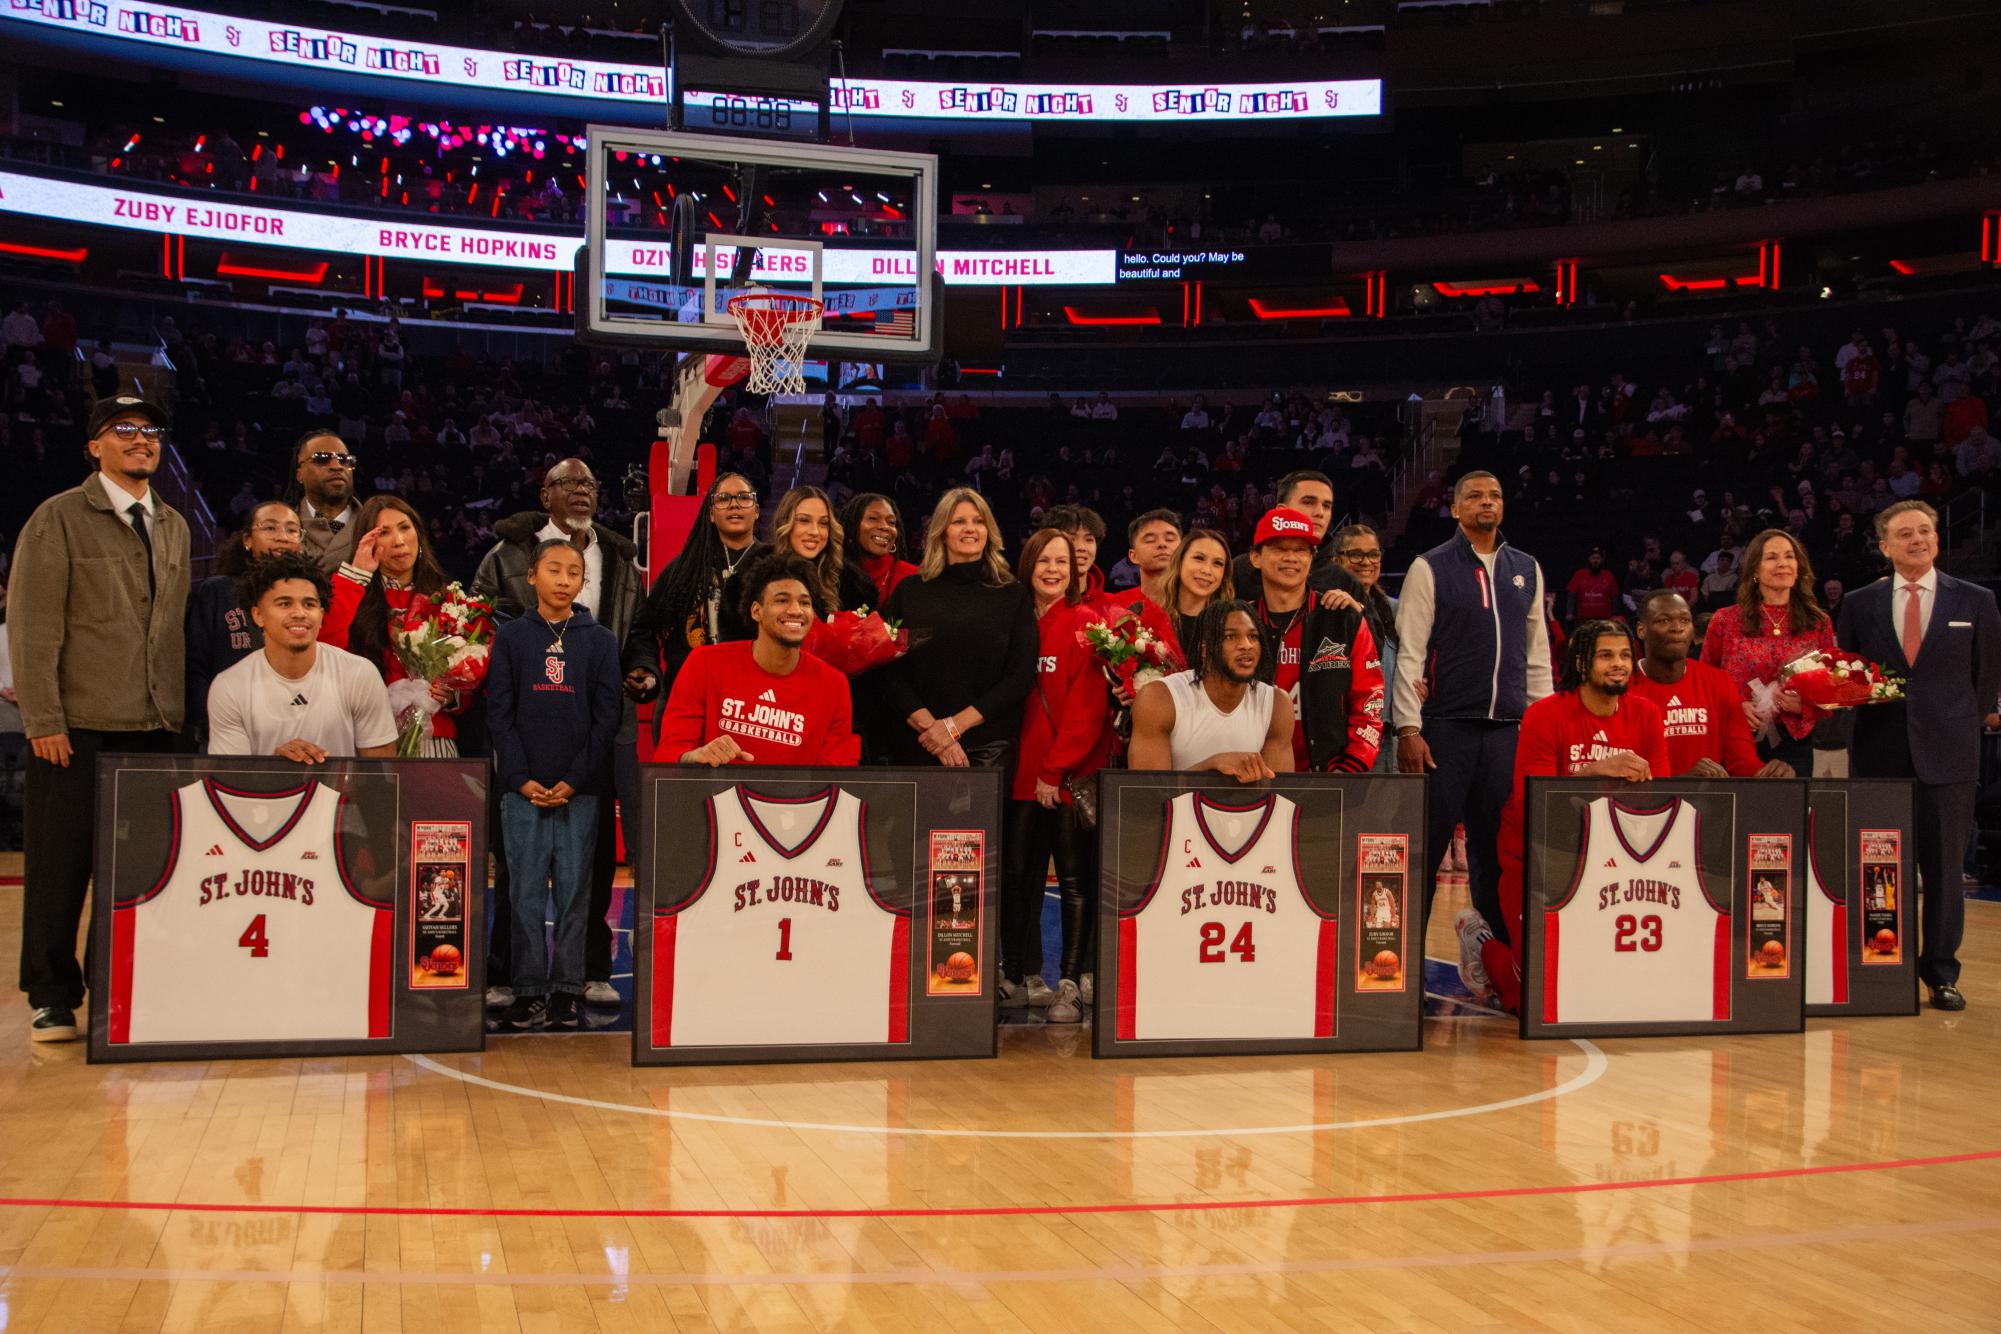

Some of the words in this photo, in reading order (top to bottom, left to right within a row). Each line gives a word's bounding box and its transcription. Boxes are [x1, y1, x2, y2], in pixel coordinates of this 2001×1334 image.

[119, 9, 200, 41] NIGHT
[269, 30, 357, 64] SENIOR
[366, 47, 440, 74] NIGHT
[503, 59, 585, 89] SENIOR
[594, 73, 664, 96] NIGHT
[830, 87, 879, 109] IGHT
[939, 87, 1017, 112] SENIOR
[1025, 93, 1093, 114] NIGHT
[1152, 88, 1231, 114] SENIOR
[1239, 91, 1309, 113] NIGHT
[113, 198, 176, 223] ZUBY
[186, 207, 284, 236] EJIOFOR
[379, 229, 451, 252] BRYCE
[461, 236, 557, 260] HOPKINS
[1124, 253, 1149, 264] hello.
[1152, 253, 1180, 264] Could
[1183, 252, 1205, 265] you?
[1208, 252, 1229, 264] May
[1232, 251, 1244, 261] be
[954, 258, 1055, 275] MITCHELL
[1120, 268, 1160, 279] beautiful
[1162, 268, 1180, 278] and
[531, 683, 577, 695] BASKETBALL
[722, 697, 745, 720] ST.
[748, 703, 805, 733] JOHN'S
[1664, 707, 1708, 726] JOHN'S
[724, 719, 796, 745] BASKETBALL
[734, 831, 742, 848] C
[1184, 839, 1192, 854] C
[200, 872, 230, 907] ST.
[234, 868, 315, 907] JOHN'S
[734, 878, 762, 913] ST.
[766, 876, 840, 912] JOHN'S
[1181, 883, 1206, 917] ST.
[1210, 880, 1277, 914] JOHN'S
[1599, 882, 1621, 912] ST.
[1623, 879, 1680, 910] JOHN'S
[238, 913, 269, 958] 4
[776, 918, 792, 961] 1
[1199, 921, 1255, 963] 24
[1614, 913, 1662, 952] 23
